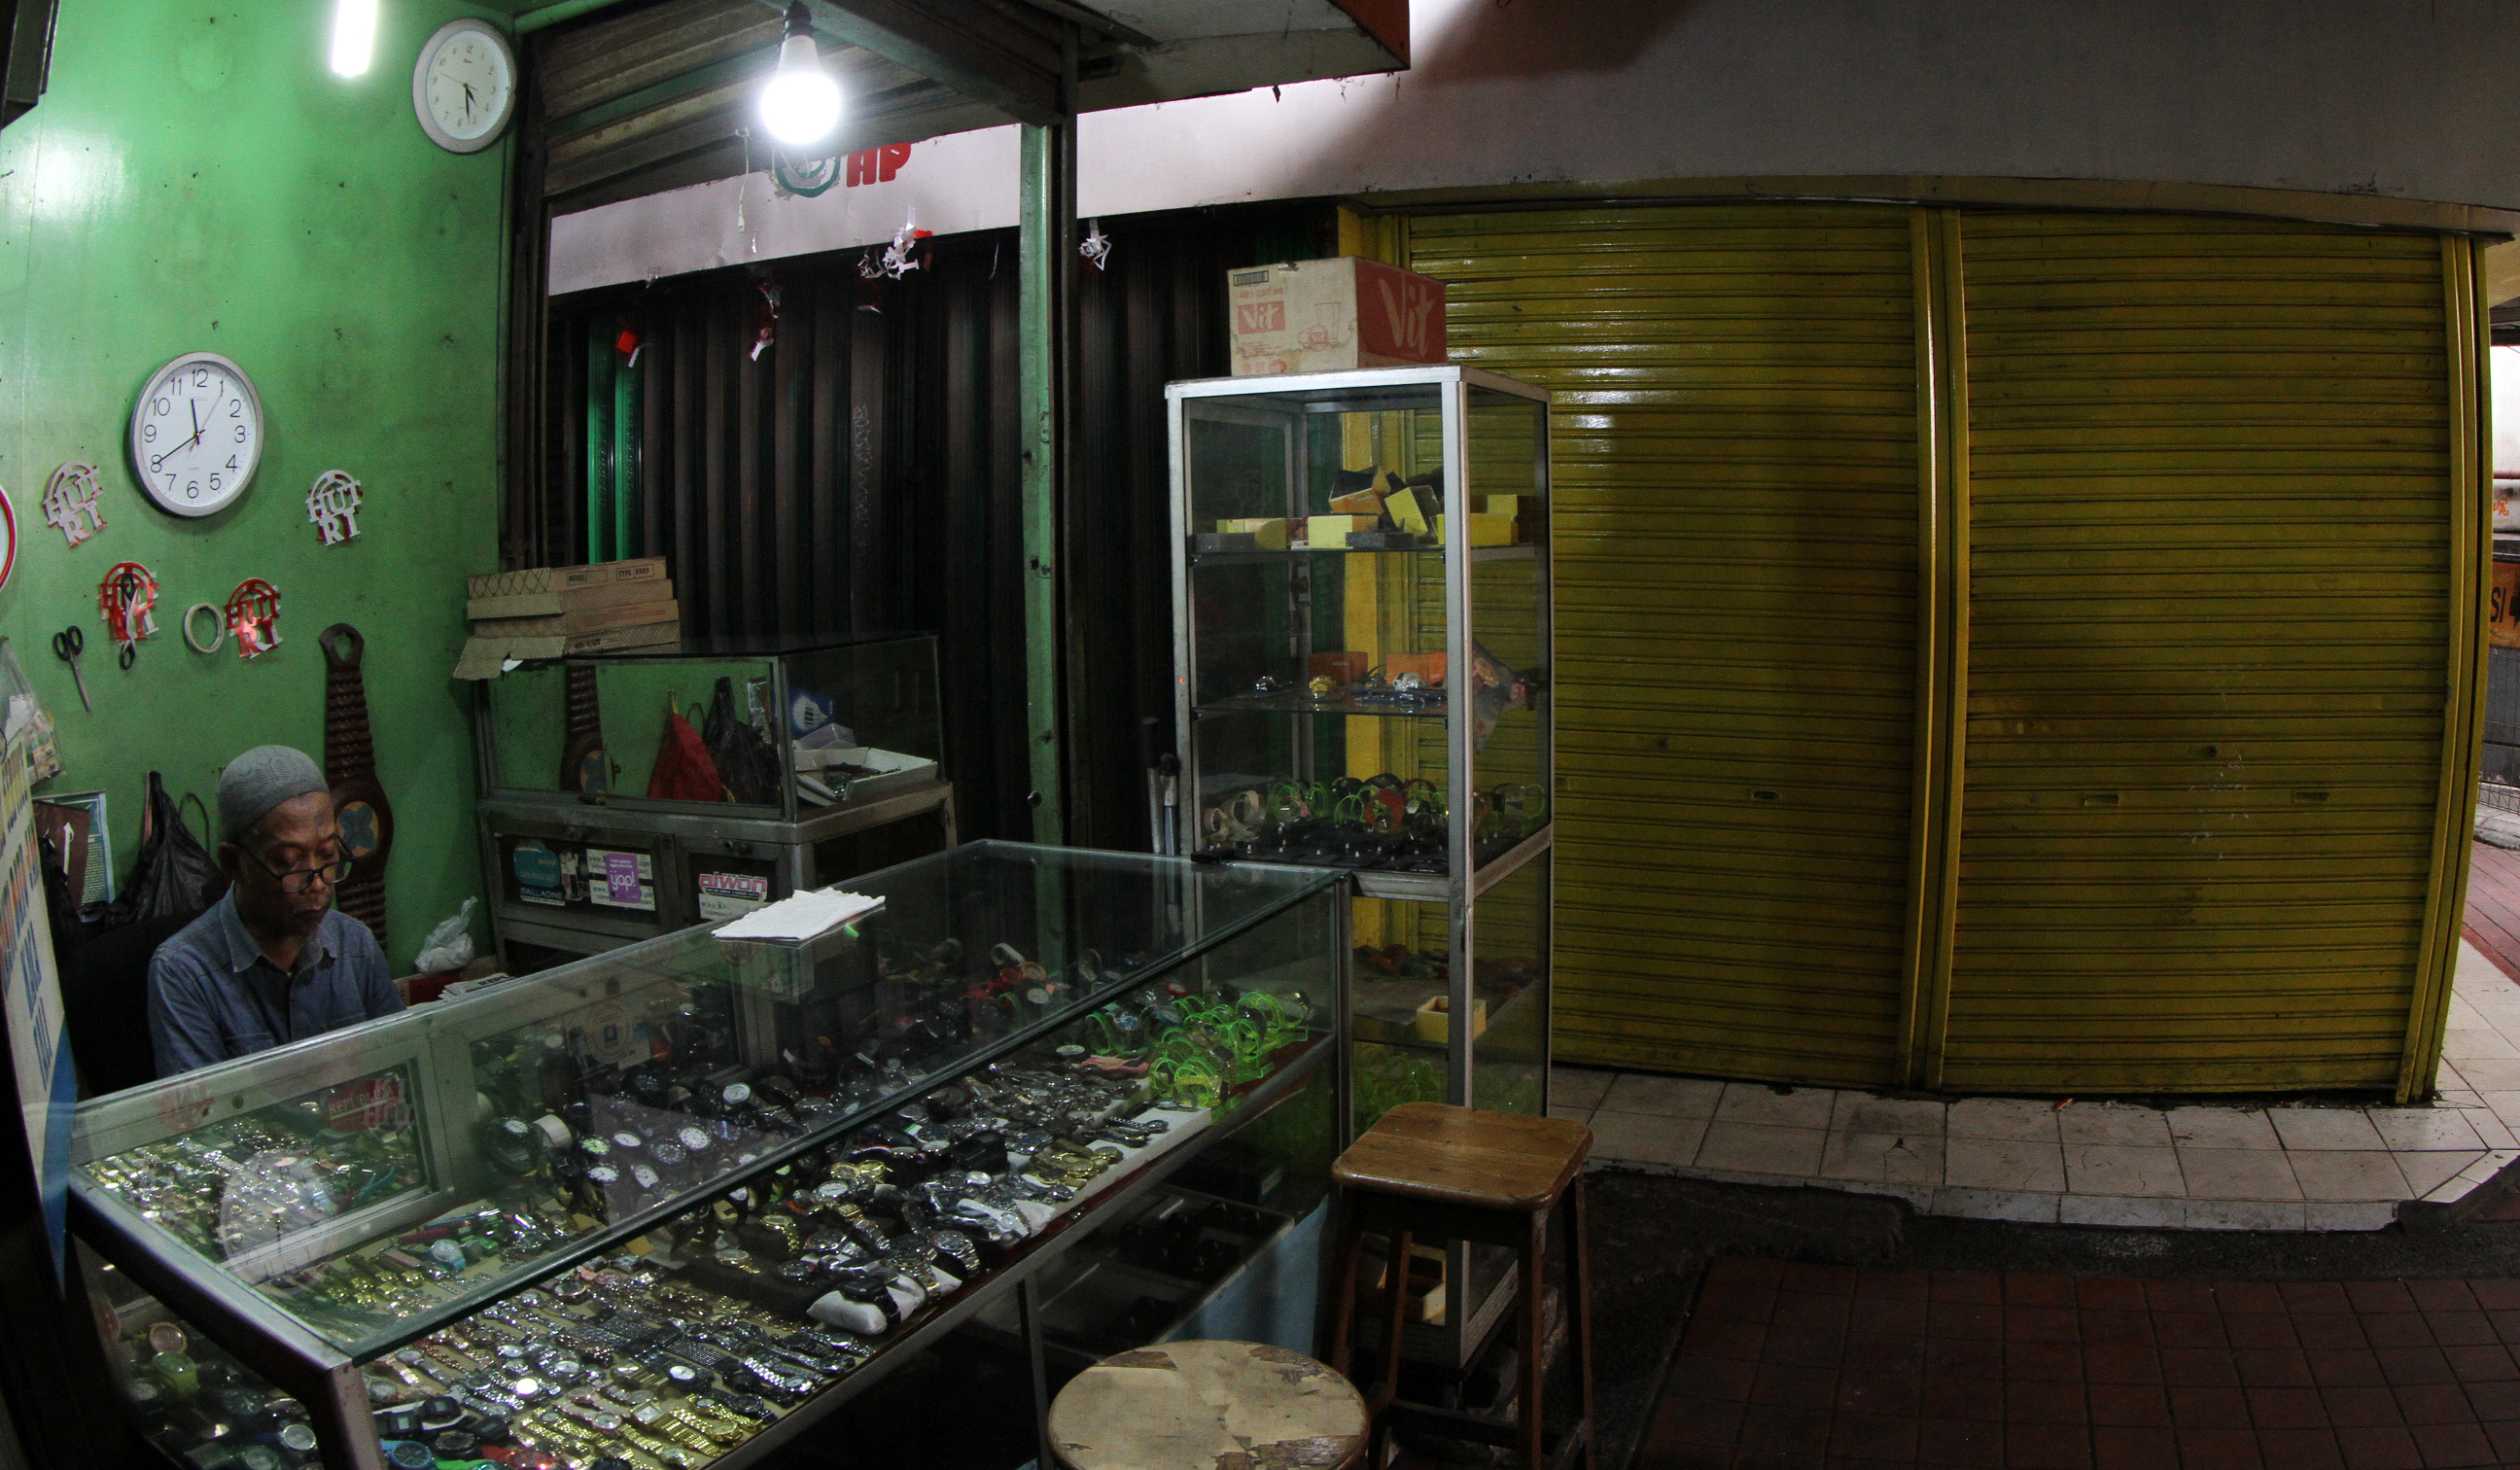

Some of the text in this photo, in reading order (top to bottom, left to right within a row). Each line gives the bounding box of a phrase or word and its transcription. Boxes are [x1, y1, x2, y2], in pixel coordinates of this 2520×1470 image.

[1242, 302, 1280, 330] Vit
[1379, 273, 1436, 358] Vit
[171, 377, 182, 396] 11
[192, 368, 208, 387] 12
[219, 379, 224, 397] 1
[153, 398, 170, 416] 10
[229, 399, 241, 417] 2
[144, 425, 157, 442] 9
[234, 425, 246, 443] 3
[151, 454, 162, 472] 8
[226, 454, 237, 472] 4
[165, 473, 177, 491] 7
[187, 480, 198, 499] 6
[209, 472, 221, 490] 5
[42, 467, 103, 526] HUT
[305, 480, 362, 522] HUT
[57, 499, 107, 548] RI
[318, 507, 361, 545] RI
[224, 593, 281, 630] HUT
[234, 619, 279, 658] RI
[699, 871, 766, 893] aiwon
